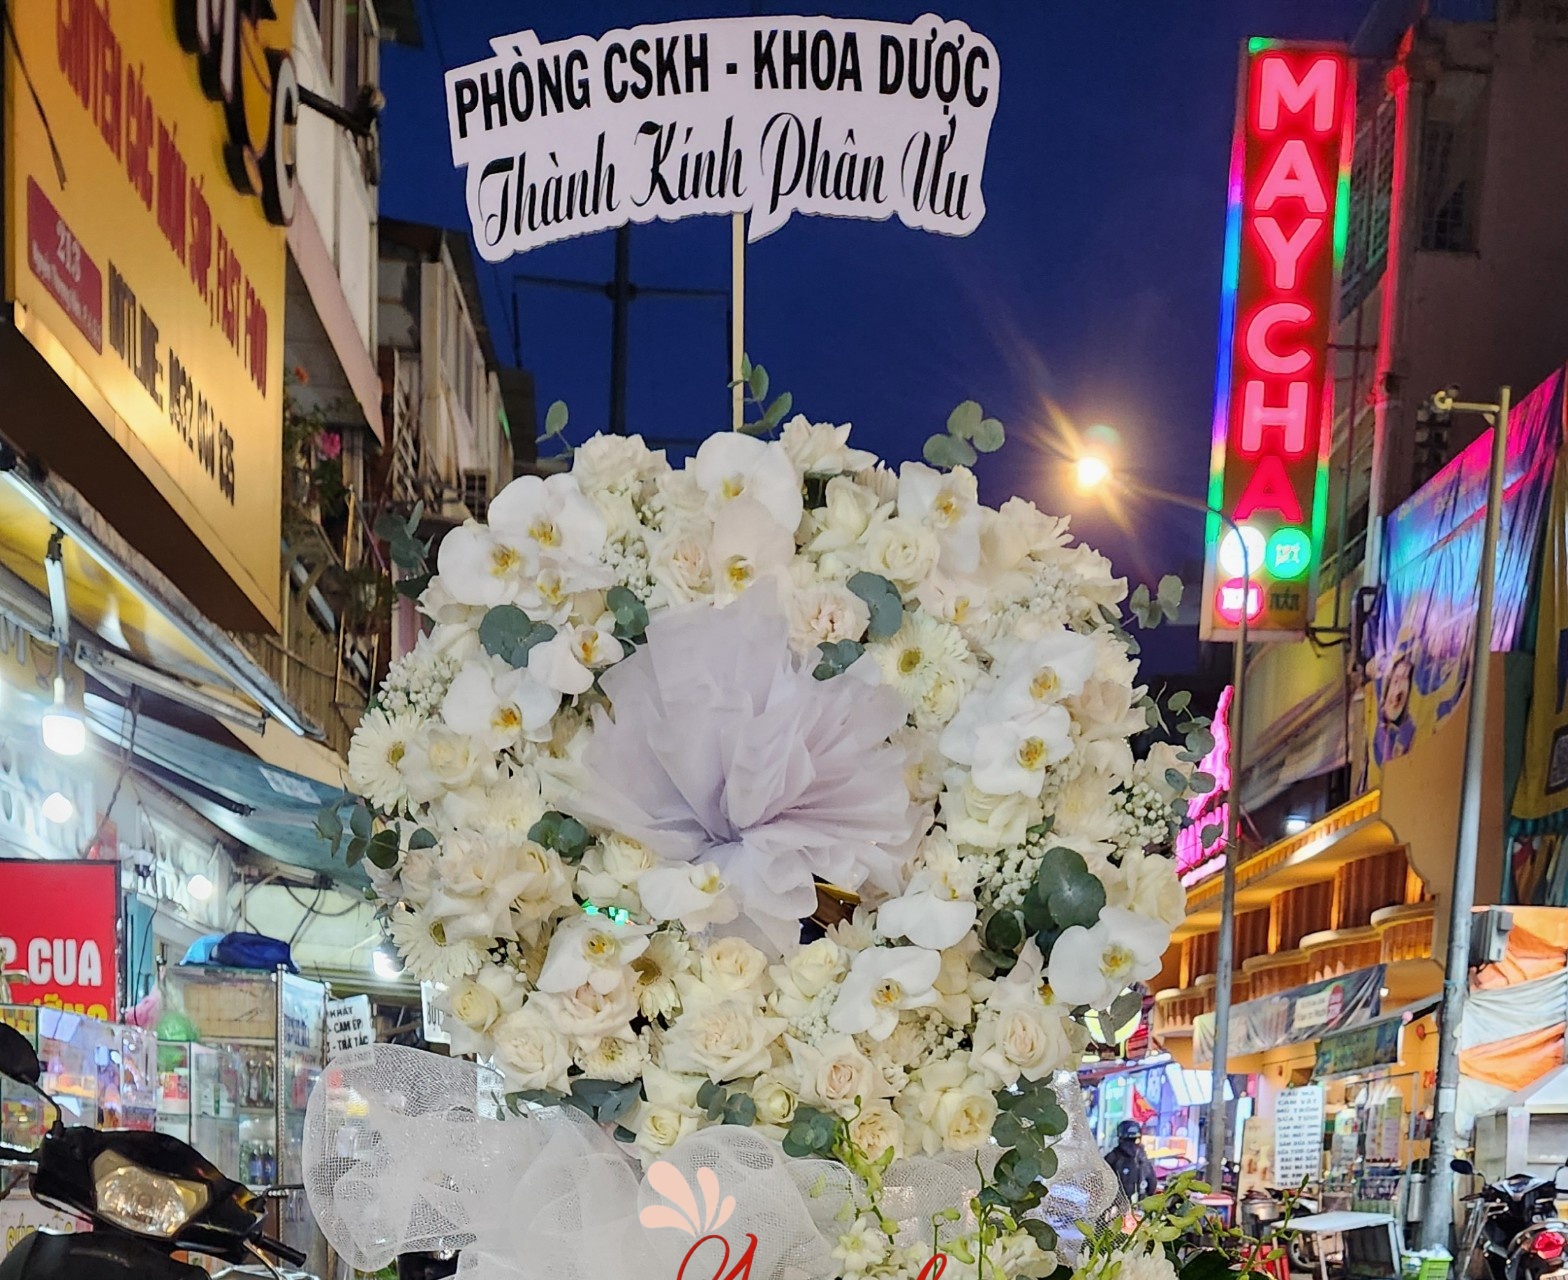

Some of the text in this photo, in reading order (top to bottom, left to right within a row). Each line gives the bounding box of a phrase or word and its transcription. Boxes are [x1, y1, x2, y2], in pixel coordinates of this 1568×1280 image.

[455, 45, 590, 140] PHÒNG
[603, 33, 709, 100] CSKH
[753, 29, 863, 92] KHOA
[879, 26, 991, 116] DƯỢC
[478, 132, 622, 247] Thành
[630, 114, 748, 207] Kính
[759, 112, 890, 215] Phân
[56, 219, 82, 283] 213
[1232, 56, 1338, 523] MAYCHA
[28, 937, 102, 987] CUA
[334, 1020, 351, 1033] CAM
